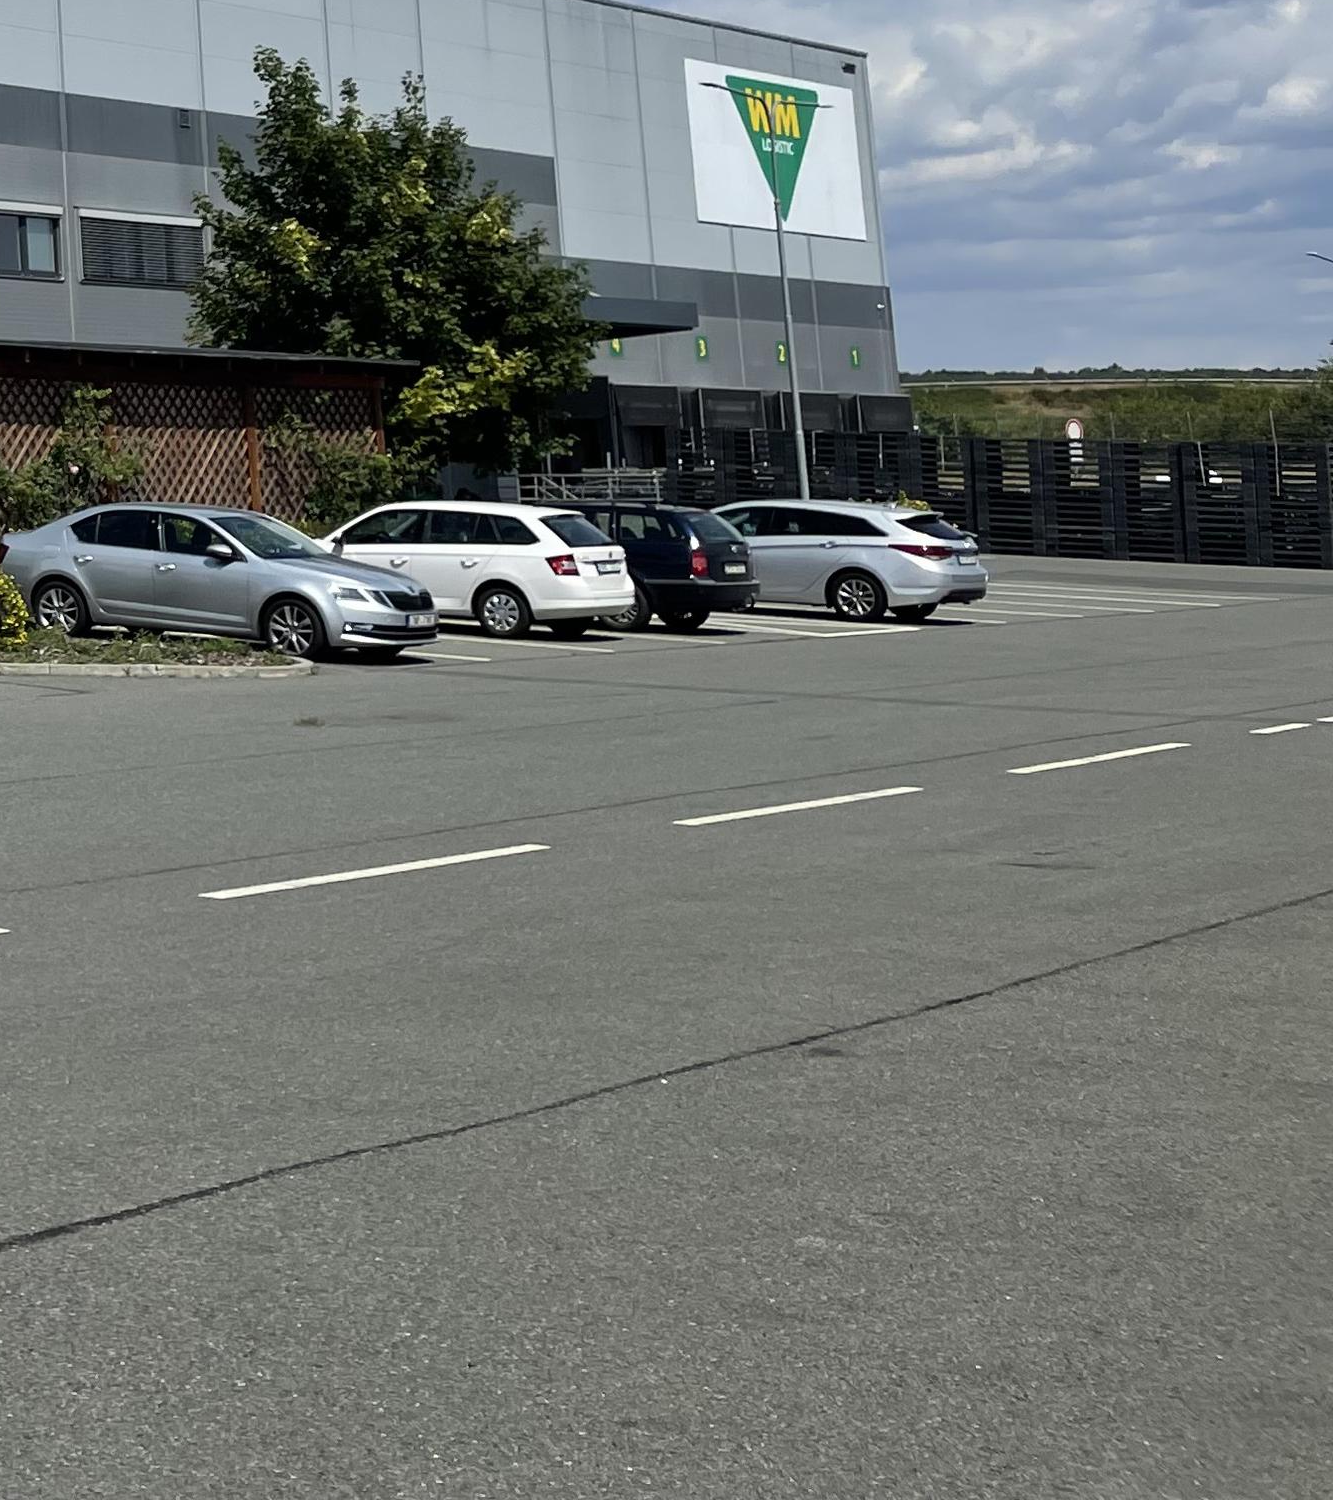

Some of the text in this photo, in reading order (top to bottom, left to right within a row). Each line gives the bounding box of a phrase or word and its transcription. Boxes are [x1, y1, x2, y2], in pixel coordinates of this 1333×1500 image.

[744, 87, 801, 139] WM
[698, 340, 707, 357] 3
[778, 344, 786, 362] 2
[852, 349, 859, 365] 1
